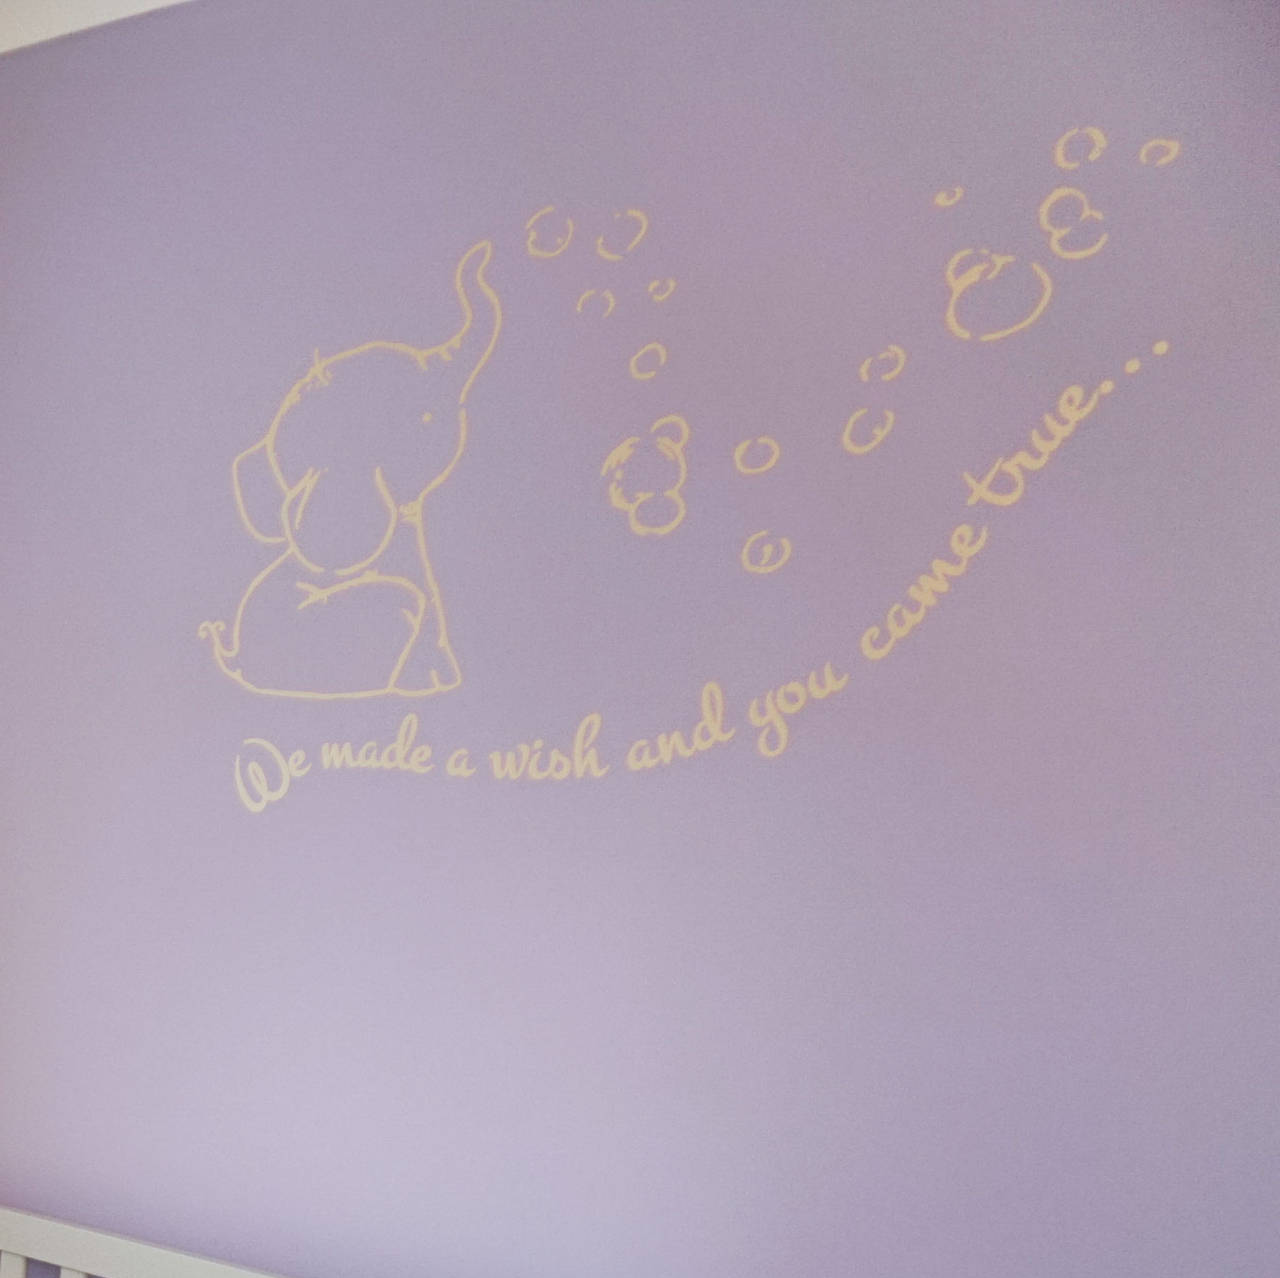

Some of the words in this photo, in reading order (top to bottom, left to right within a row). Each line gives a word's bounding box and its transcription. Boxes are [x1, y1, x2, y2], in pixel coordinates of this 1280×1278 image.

[235, 738, 312, 813] We
[321, 713, 434, 774] made
[445, 747, 478, 778] a
[488, 712, 610, 781] wish
[626, 680, 736, 771] and
[748, 663, 850, 759] you
[860, 523, 989, 662] came
